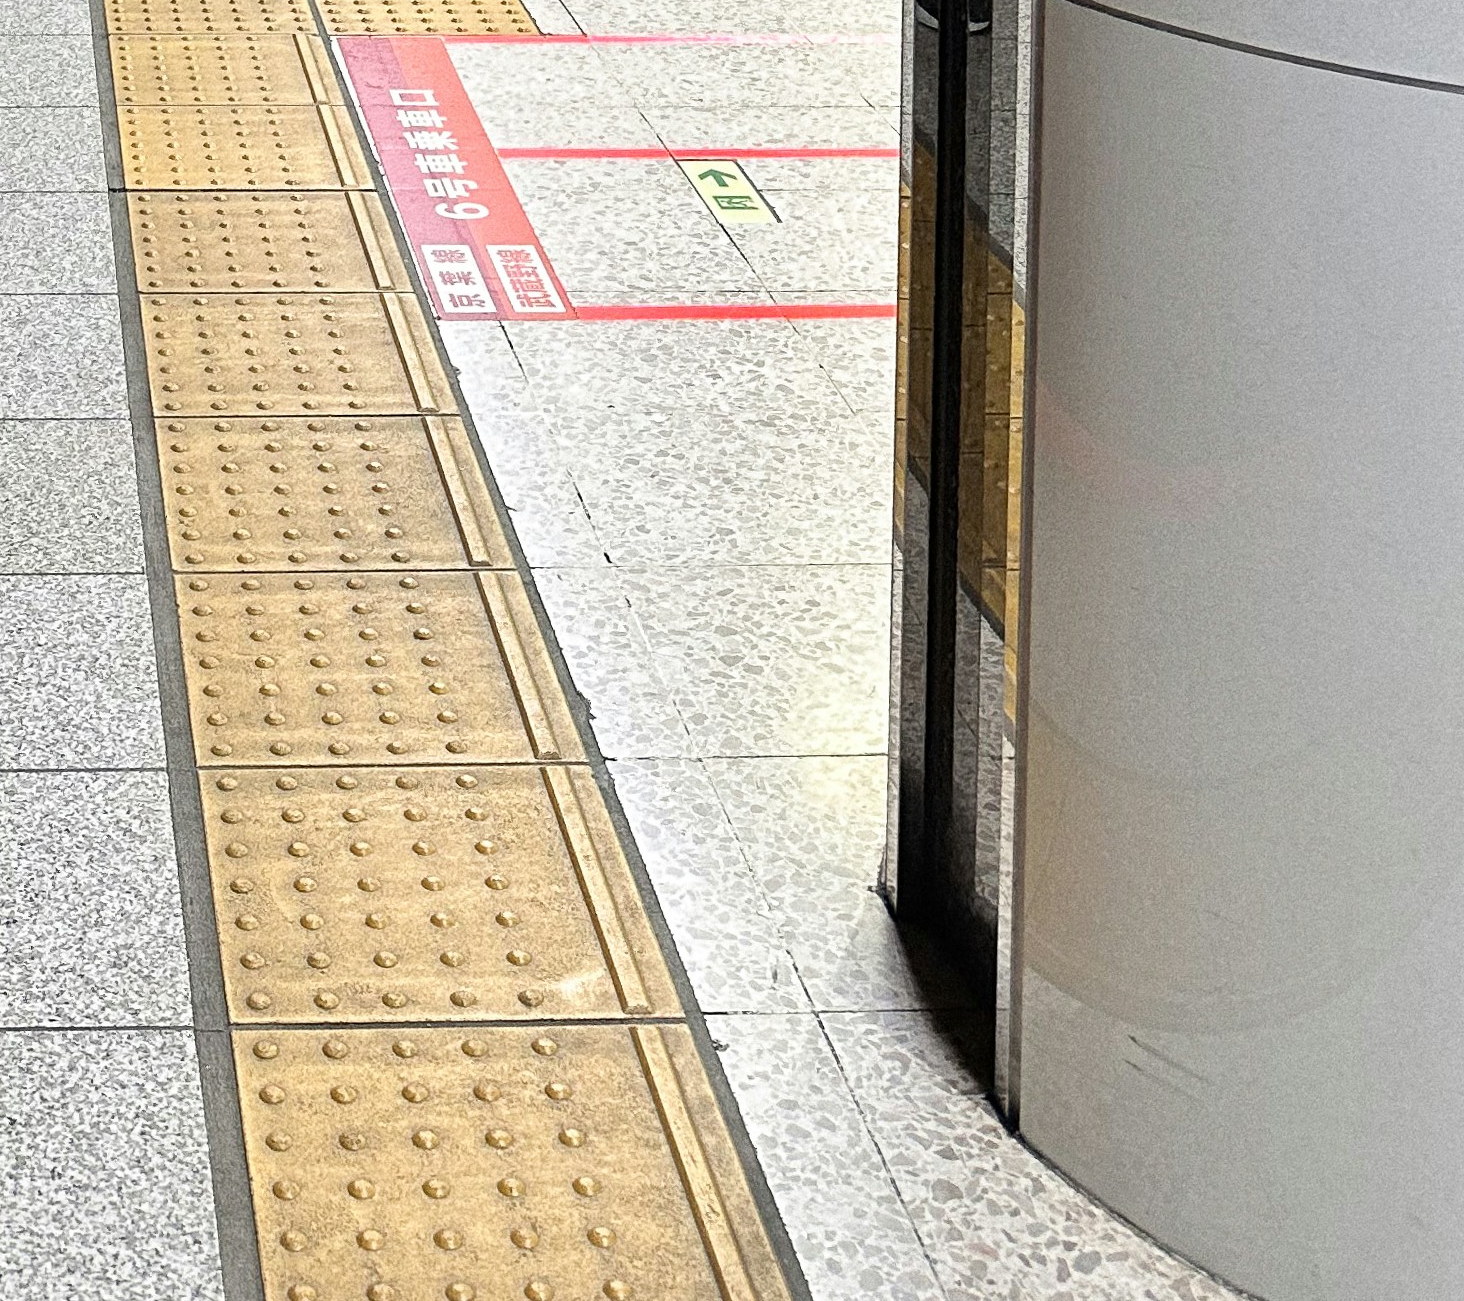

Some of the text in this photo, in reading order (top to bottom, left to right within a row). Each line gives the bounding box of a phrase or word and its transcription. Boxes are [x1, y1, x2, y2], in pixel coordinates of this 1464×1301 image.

[389, 89, 490, 219] 6号車乗車口
[430, 249, 486, 308] 京葉線
[496, 249, 558, 308] 武蔵野線
